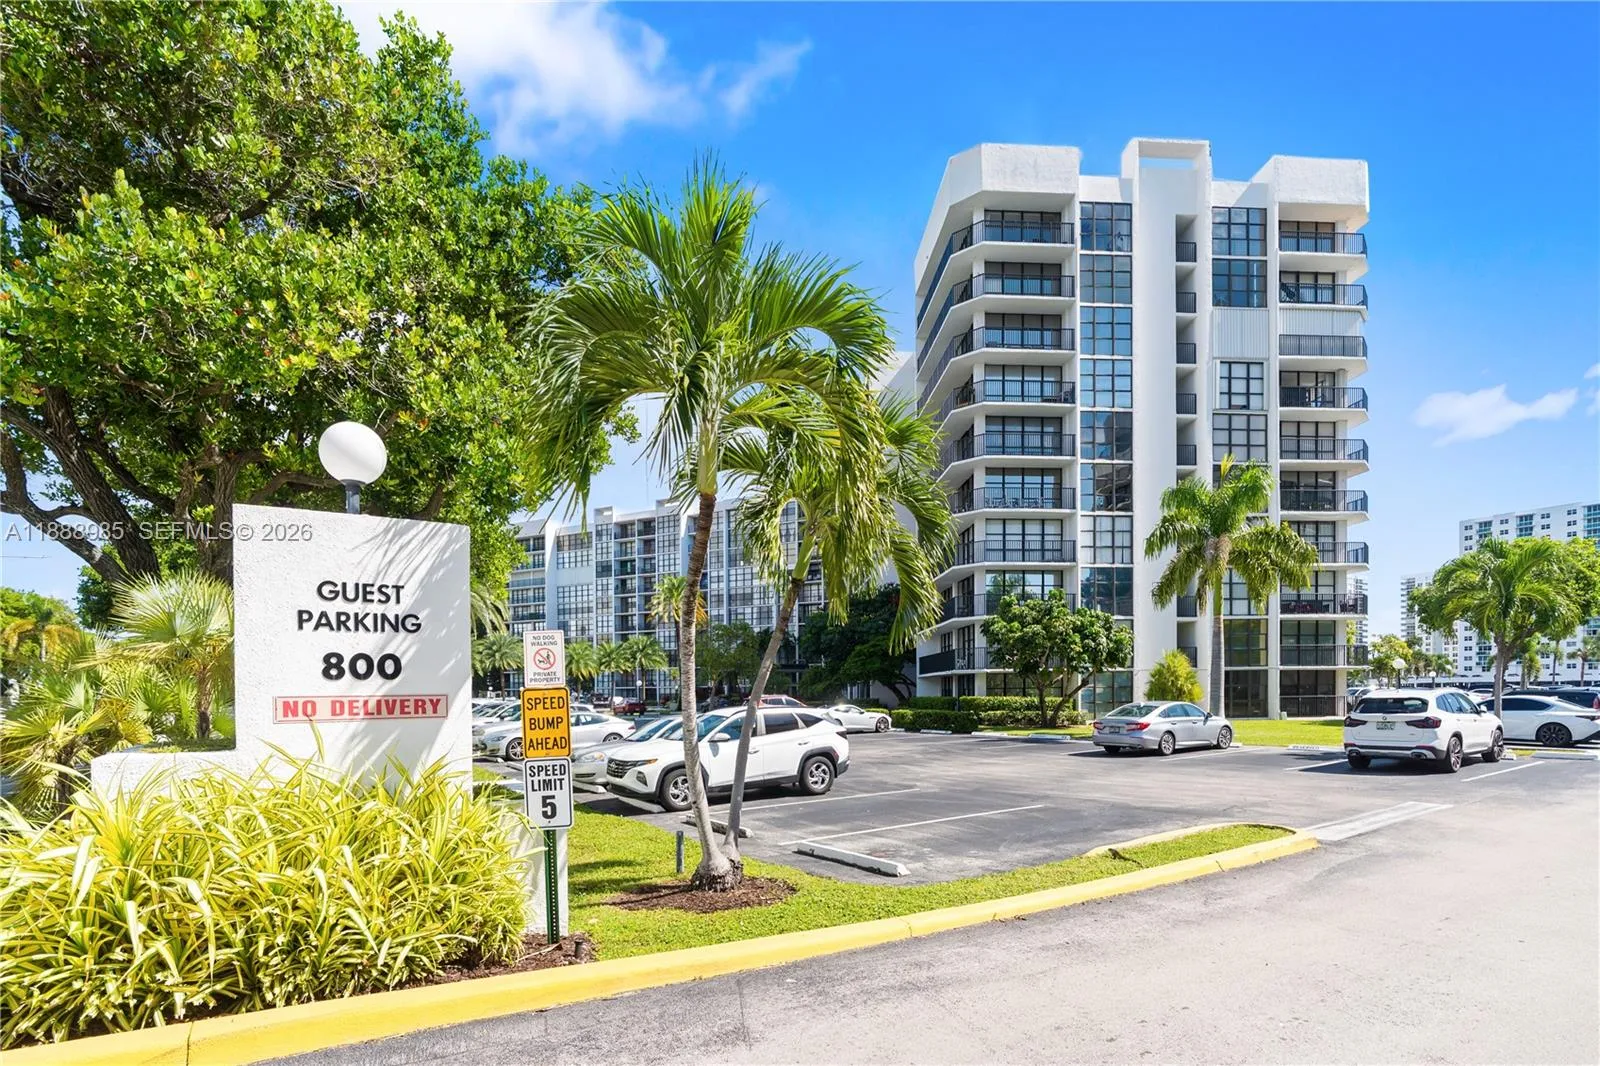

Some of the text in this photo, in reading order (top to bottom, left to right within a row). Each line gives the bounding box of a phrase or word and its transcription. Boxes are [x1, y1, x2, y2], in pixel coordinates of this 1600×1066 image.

[316, 580, 404, 604] GUEST
[296, 609, 422, 634] PARKING
[321, 652, 402, 681] 800
[282, 698, 442, 718] NO DELIVERY
[526, 696, 565, 711] SPEED
[529, 716, 564, 731] BUMP
[527, 736, 567, 751] AHEAD
[528, 763, 567, 778] SPEED
[531, 777, 565, 792] LIMIT
[541, 794, 557, 820] 5
